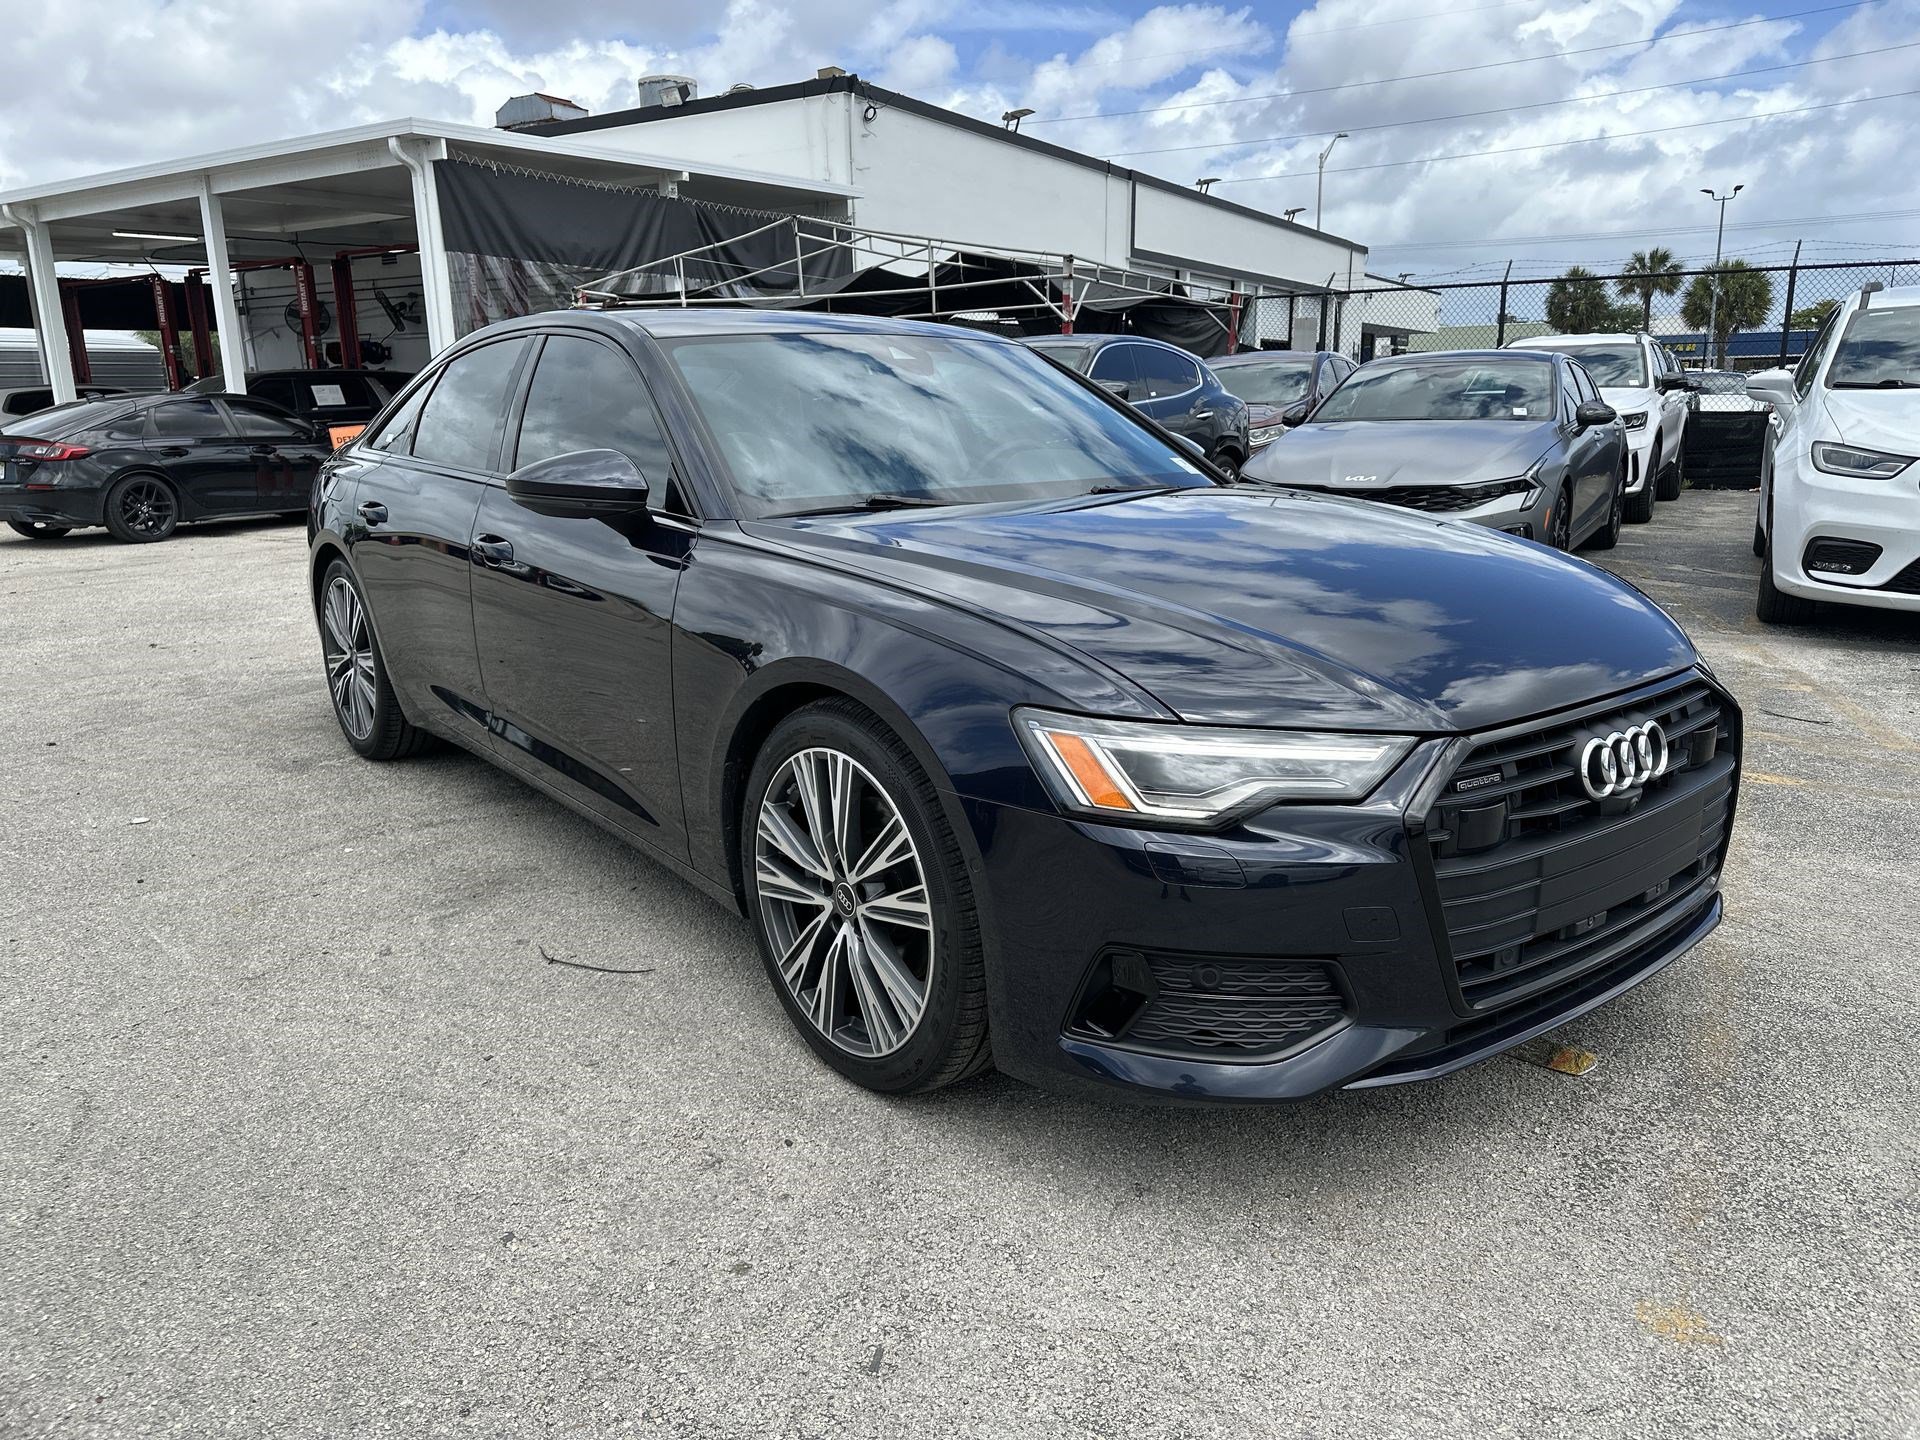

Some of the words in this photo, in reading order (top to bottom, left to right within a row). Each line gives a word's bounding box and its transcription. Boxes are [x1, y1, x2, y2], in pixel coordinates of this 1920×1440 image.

[157, 296, 166, 323] ROTARY
[299, 283, 309, 311] ROTARY
[1460, 775, 1500, 790] quattro
